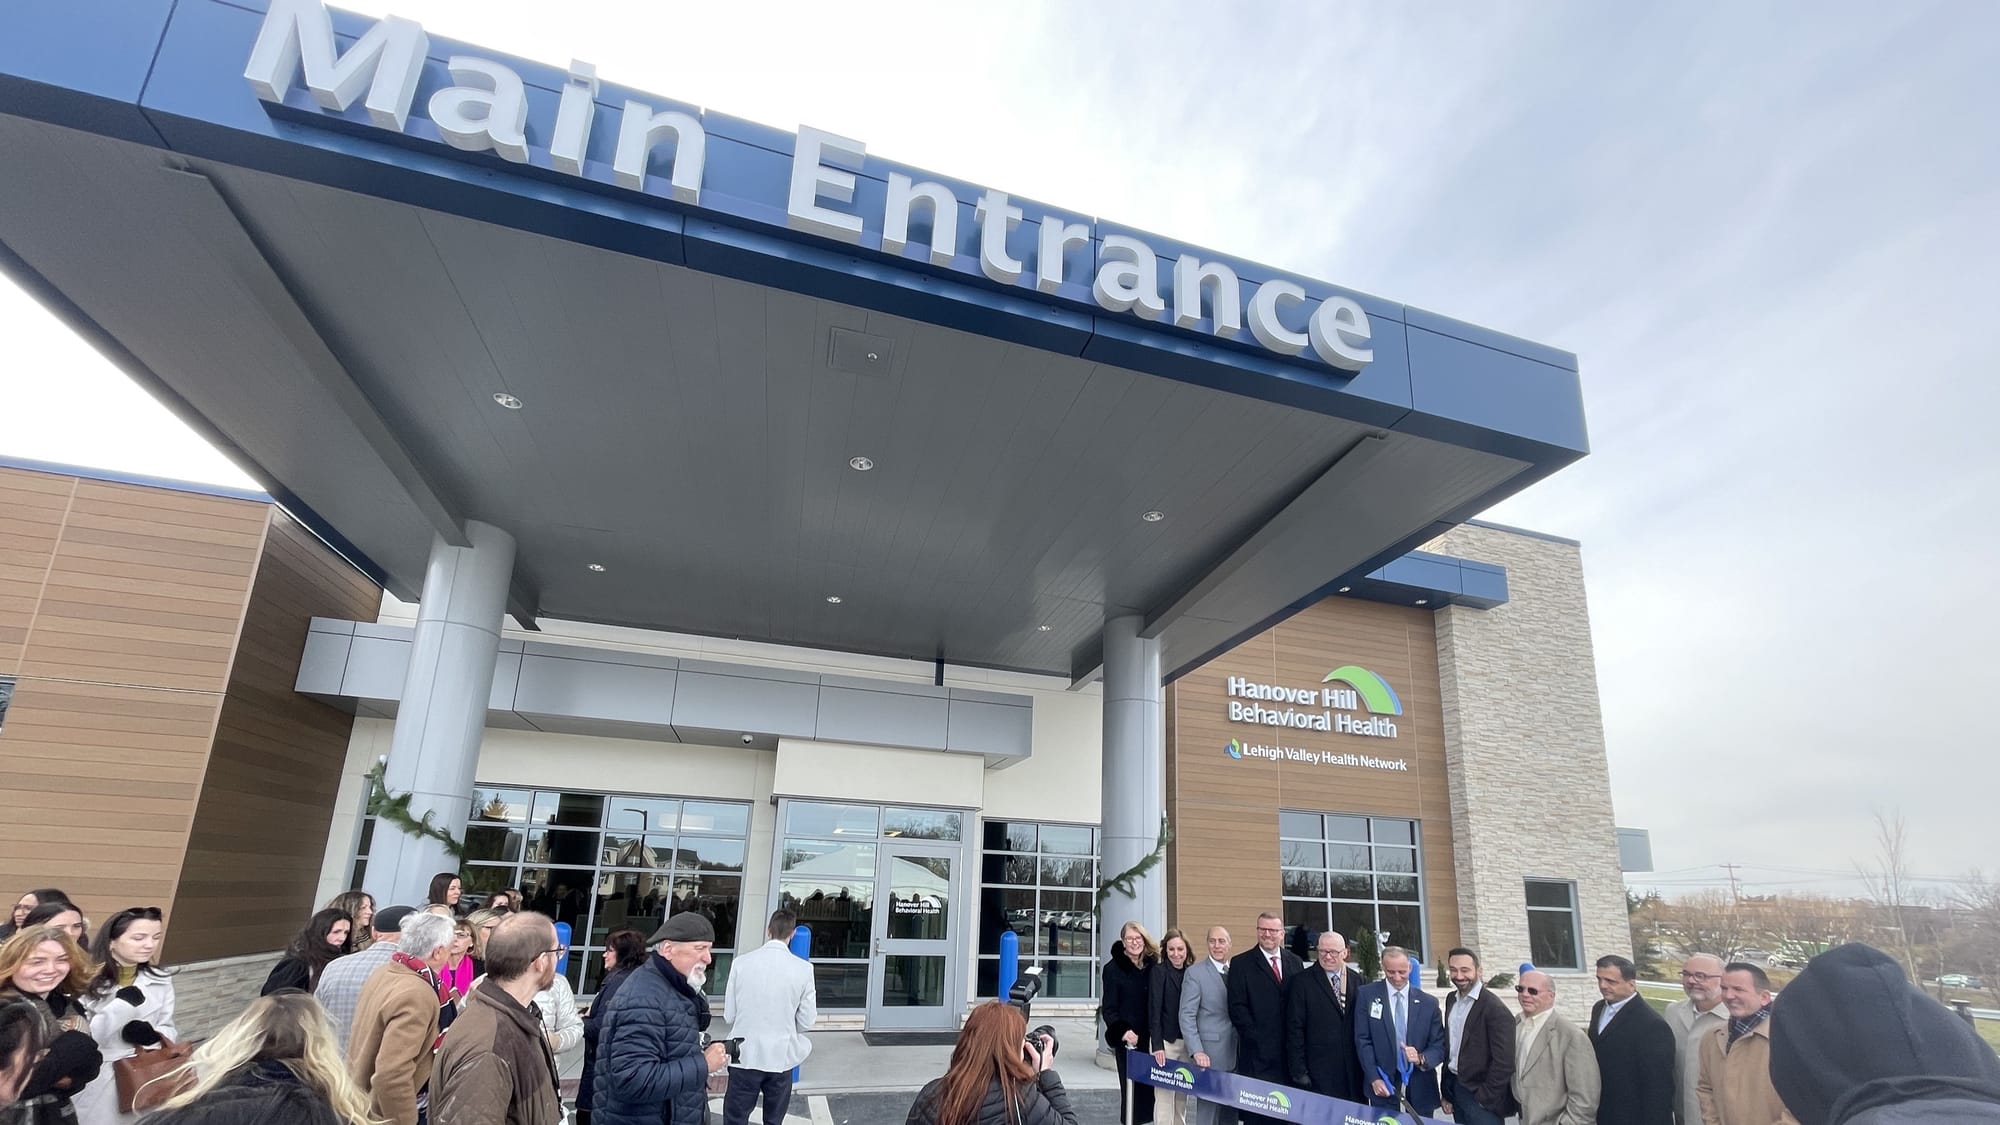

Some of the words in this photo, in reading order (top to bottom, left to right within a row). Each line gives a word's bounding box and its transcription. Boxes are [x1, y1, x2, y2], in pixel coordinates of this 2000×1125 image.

[244, 0, 706, 205] Main
[787, 124, 1374, 372] Entrance
[1227, 676, 1319, 705] Hanover
[1322, 688, 1358, 710] Hill
[1228, 701, 1331, 732] Behavioral
[1335, 713, 1397, 738] Health
[1243, 743, 1284, 760] Lehigh
[1285, 748, 1321, 765] Valley
[1322, 751, 1359, 767] Health
[1360, 755, 1407, 771] Network
[1150, 1073, 1176, 1086] Behavioral
[1176, 1080, 1193, 1090] Health
[1151, 1067, 1174, 1079] Hanover
[1174, 1072, 1184, 1080] Hill
[1239, 1097, 1269, 1110] Behavioral
[1269, 1104, 1289, 1115] Health
[1240, 1090, 1266, 1102] Hanover
[1267, 1095, 1278, 1105] Hill
